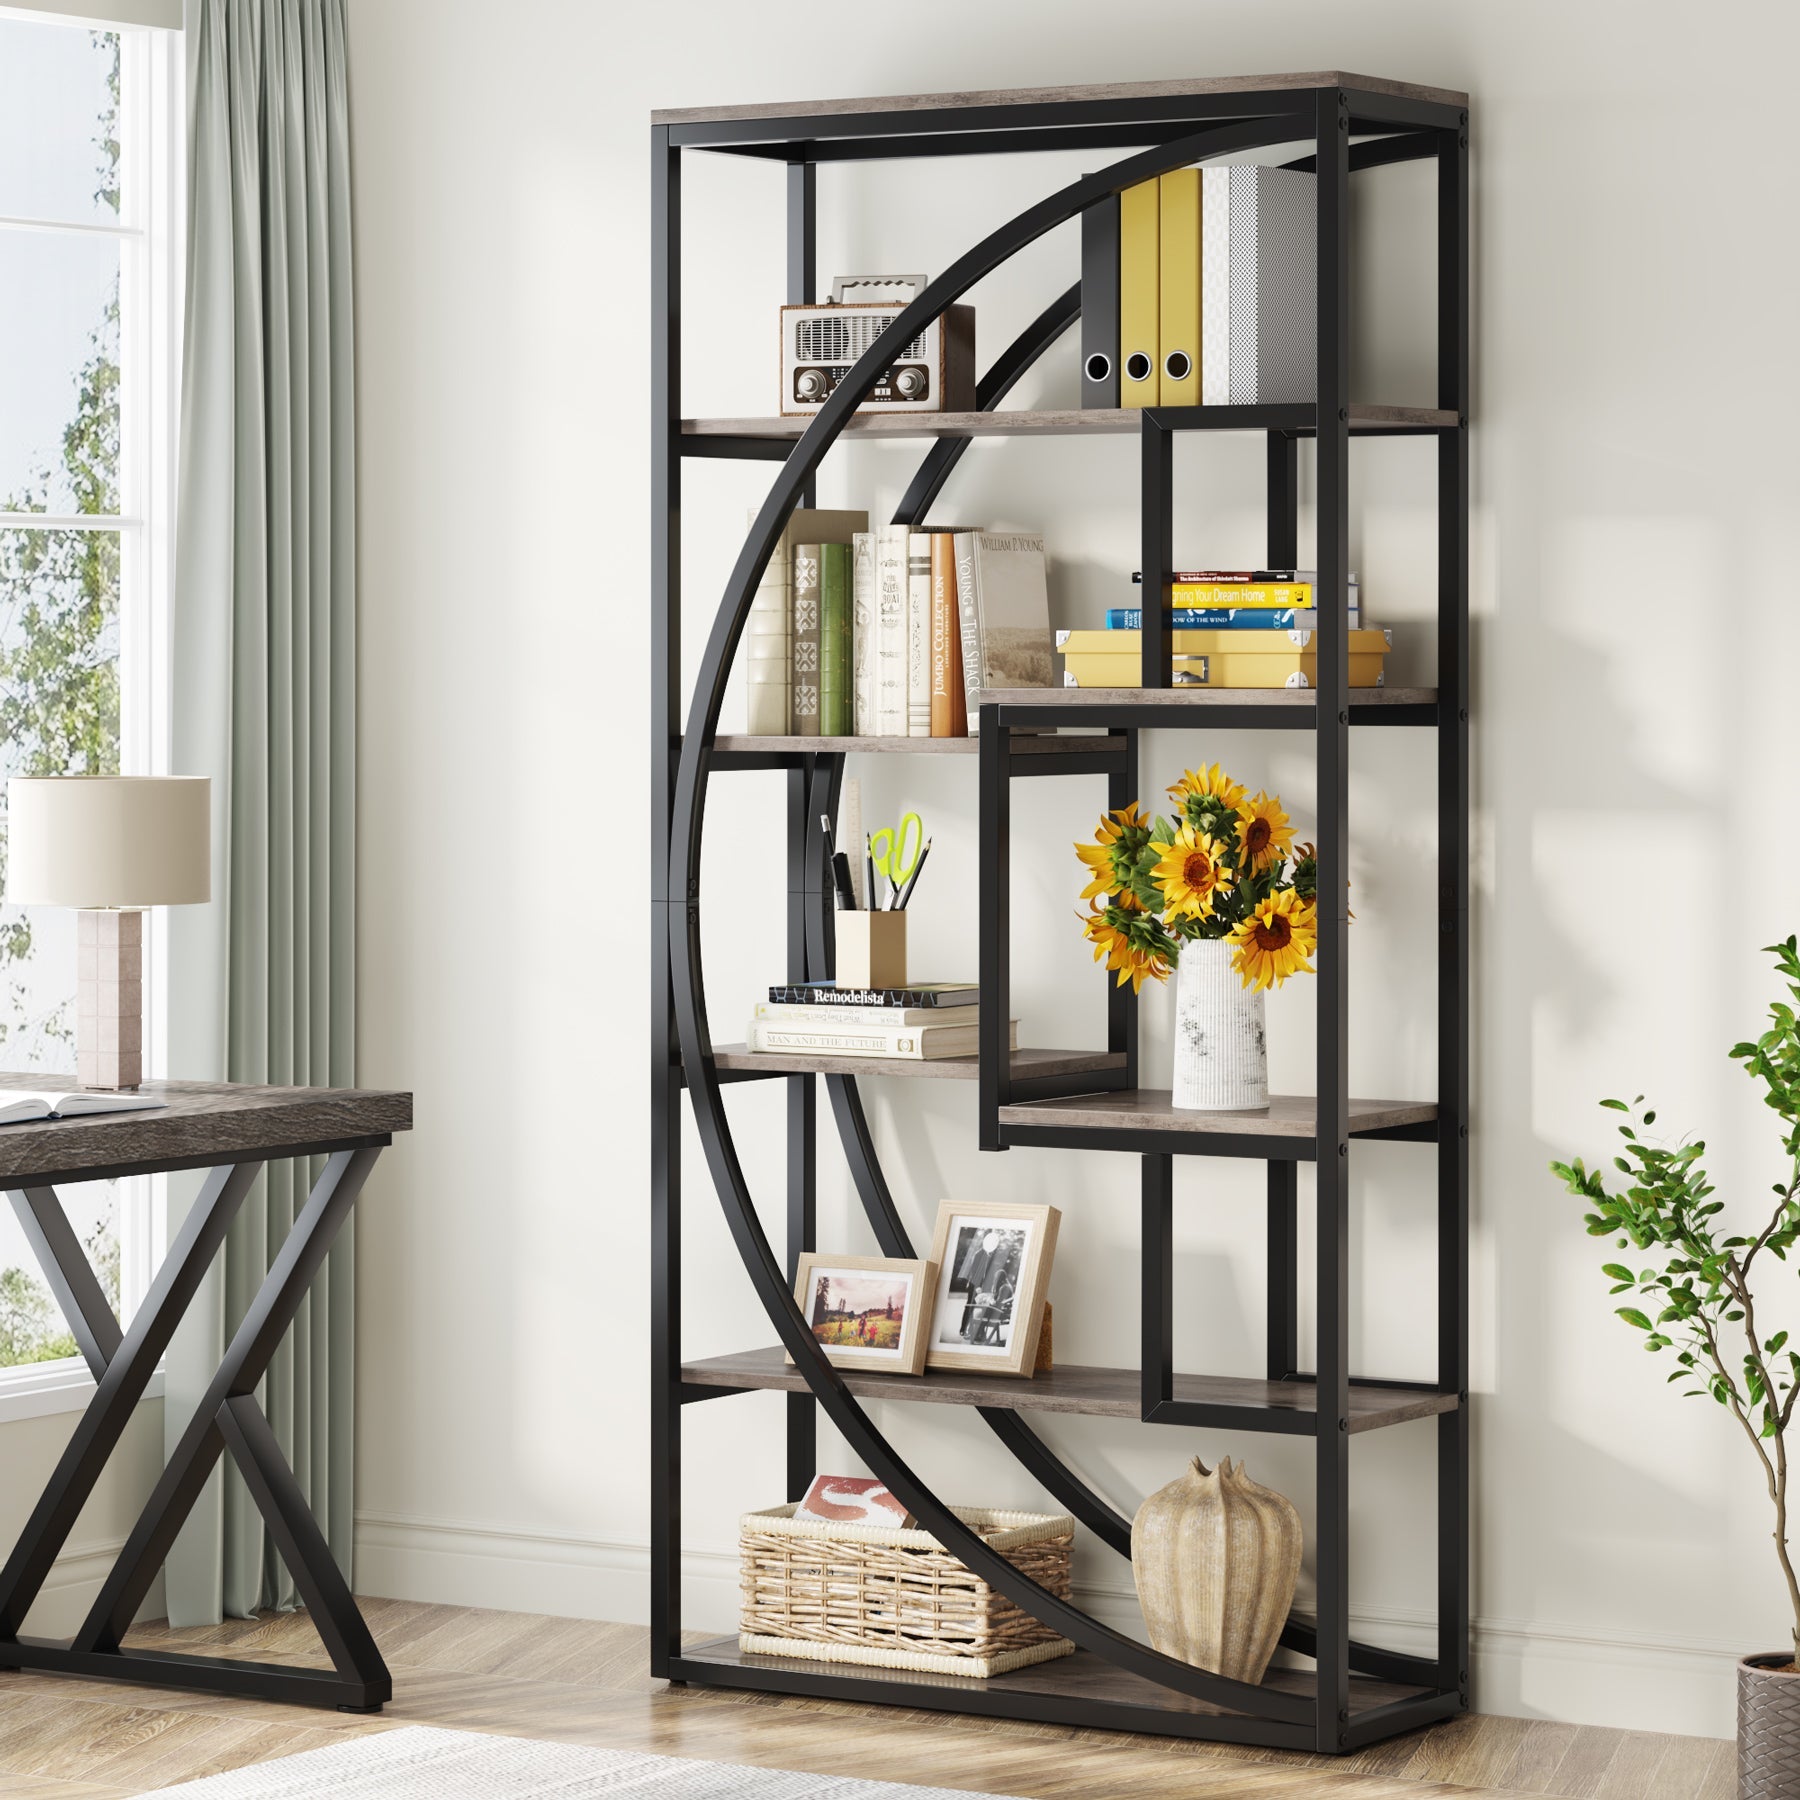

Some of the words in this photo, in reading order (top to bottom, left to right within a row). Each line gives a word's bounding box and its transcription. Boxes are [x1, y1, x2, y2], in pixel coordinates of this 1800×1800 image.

[980, 536, 1011, 551] WILLIAM
[1012, 537, 1018, 552] P.
[1018, 537, 1044, 552] YOUNG
[959, 556, 974, 606] YOUNG
[1195, 589, 1213, 602] Your
[1213, 588, 1240, 602] Dream
[1241, 588, 1266, 602] Home
[933, 576, 945, 652] COLLECTION
[962, 619, 977, 646] THE
[933, 655, 947, 697] JUMBO
[965, 650, 980, 697] SHACK
[814, 989, 884, 1004] Remodelista
[767, 1035, 790, 1044] MAN
[794, 1036, 816, 1045] AND
[820, 1037, 843, 1046] THE
[845, 1039, 887, 1049] FUTURE
